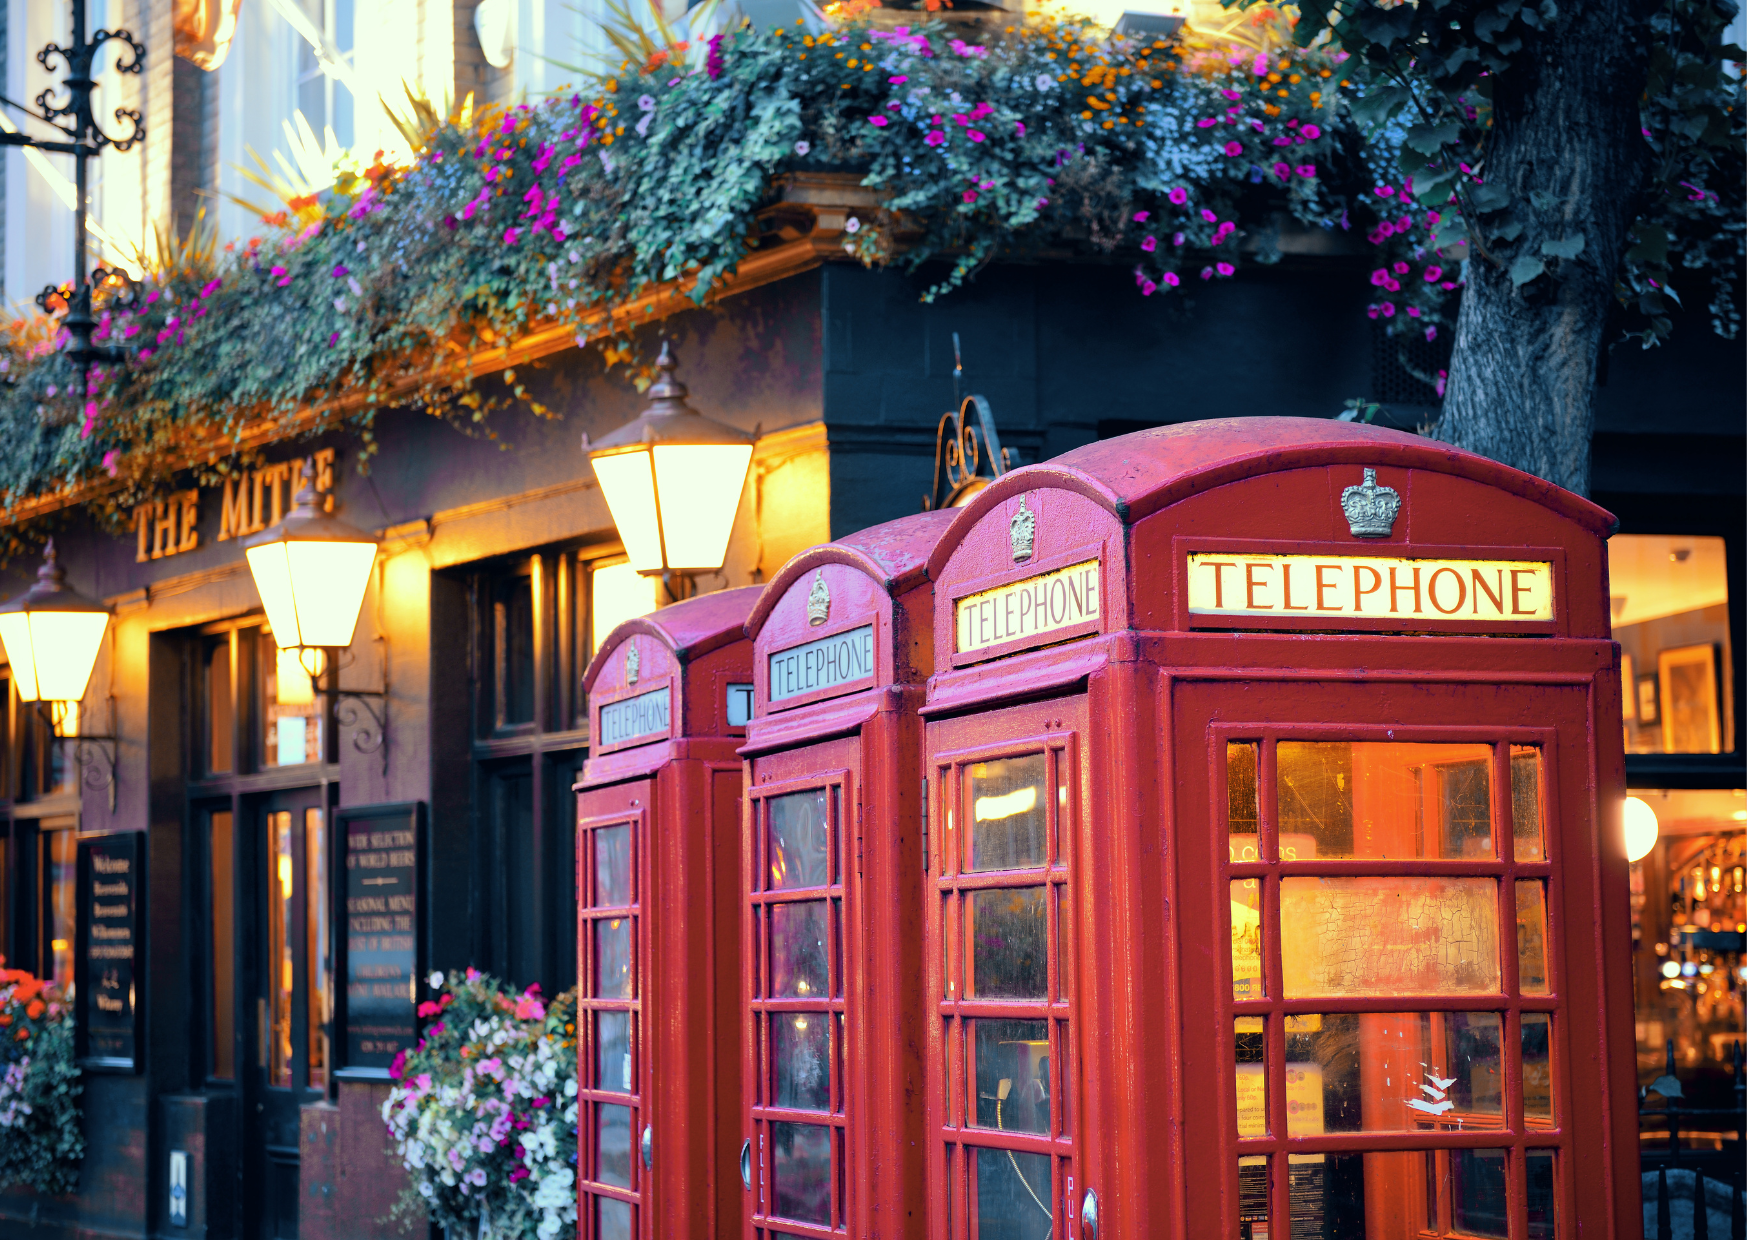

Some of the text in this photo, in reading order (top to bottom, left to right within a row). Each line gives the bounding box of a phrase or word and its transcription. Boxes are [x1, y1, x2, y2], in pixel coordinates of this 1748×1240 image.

[132, 487, 198, 563] THE
[964, 567, 1098, 646] TELEPHONE
[1199, 561, 1537, 615] TELEPHONE
[775, 633, 872, 696] TELEPHONE
[604, 694, 669, 742] TELEPHONE
